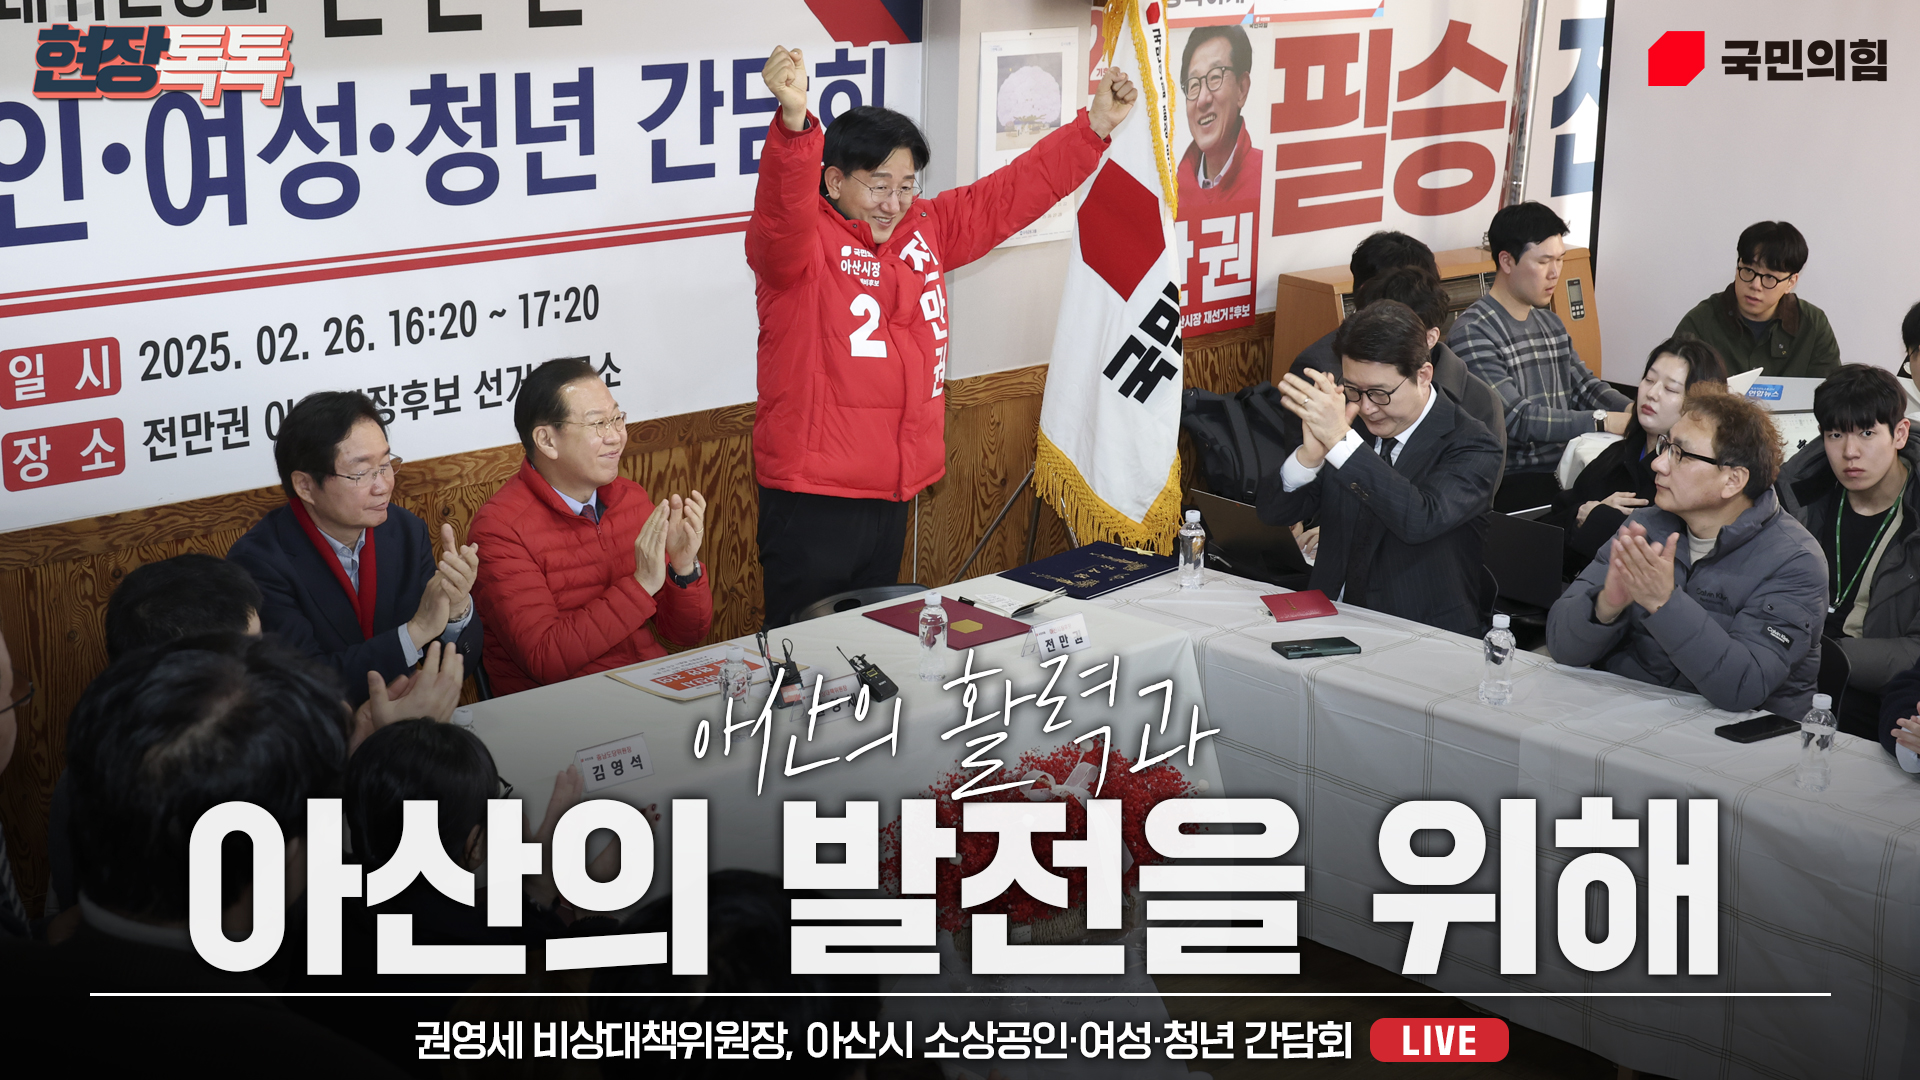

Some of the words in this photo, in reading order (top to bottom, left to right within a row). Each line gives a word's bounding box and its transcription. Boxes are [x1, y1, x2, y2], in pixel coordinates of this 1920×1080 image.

[1270, 19, 1507, 236] 필승
[840, 258, 881, 277] 아산시장
[139, 331, 241, 382] 2025.
[256, 323, 310, 367] 02.
[323, 315, 375, 360] 26.
[389, 301, 477, 348] 16:20
[517, 284, 600, 330] 17:20
[849, 293, 887, 358] 2
[142, 402, 250, 463] 전만권
[263, 372, 462, 442] 아장후보
[1748, 389, 1780, 398] 연합뉴스
[1766, 625, 1781, 639] Calvin
